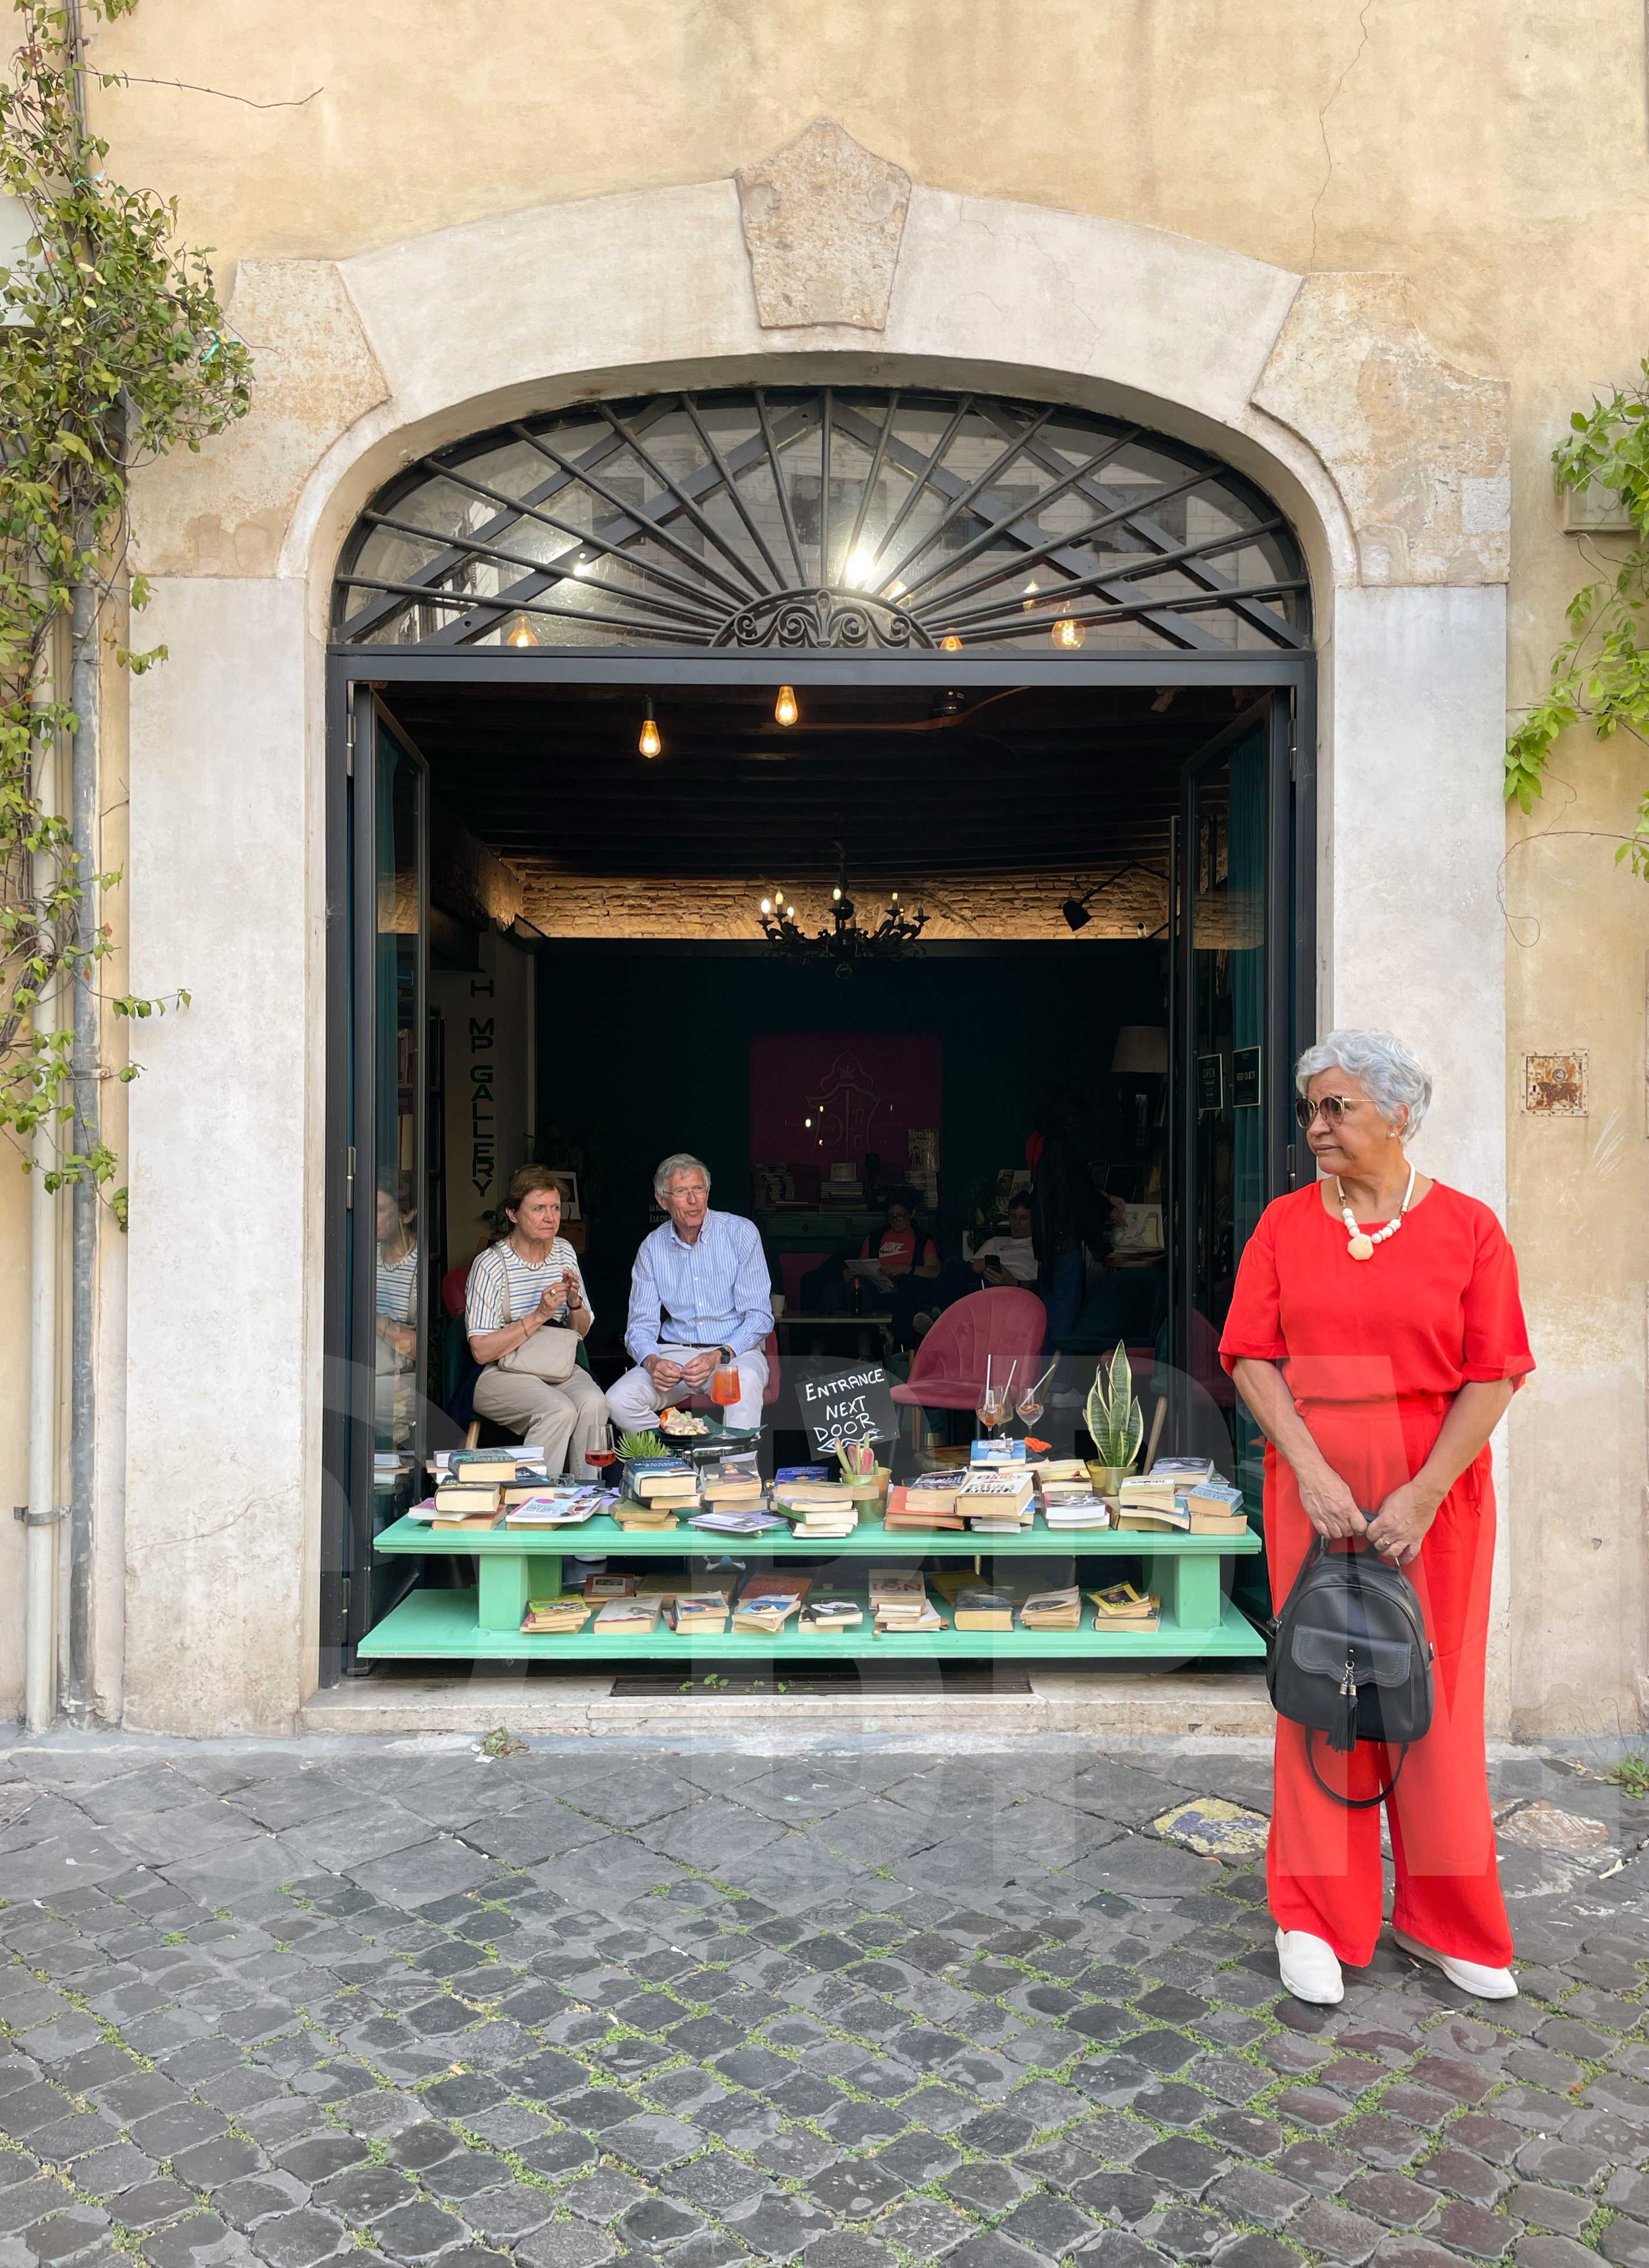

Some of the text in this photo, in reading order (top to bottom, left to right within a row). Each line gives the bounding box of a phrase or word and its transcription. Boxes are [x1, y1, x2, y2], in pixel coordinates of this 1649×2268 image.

[470, 979, 494, 998] H
[1203, 1067, 1216, 1079] OPEN
[470, 1064, 495, 1197] GALLERY
[880, 1241, 904, 1252] NIKE
[805, 1369, 885, 1401] ENTRANCE
[826, 1396, 866, 1420] NEXT
[813, 1412, 875, 1442] DOOR
